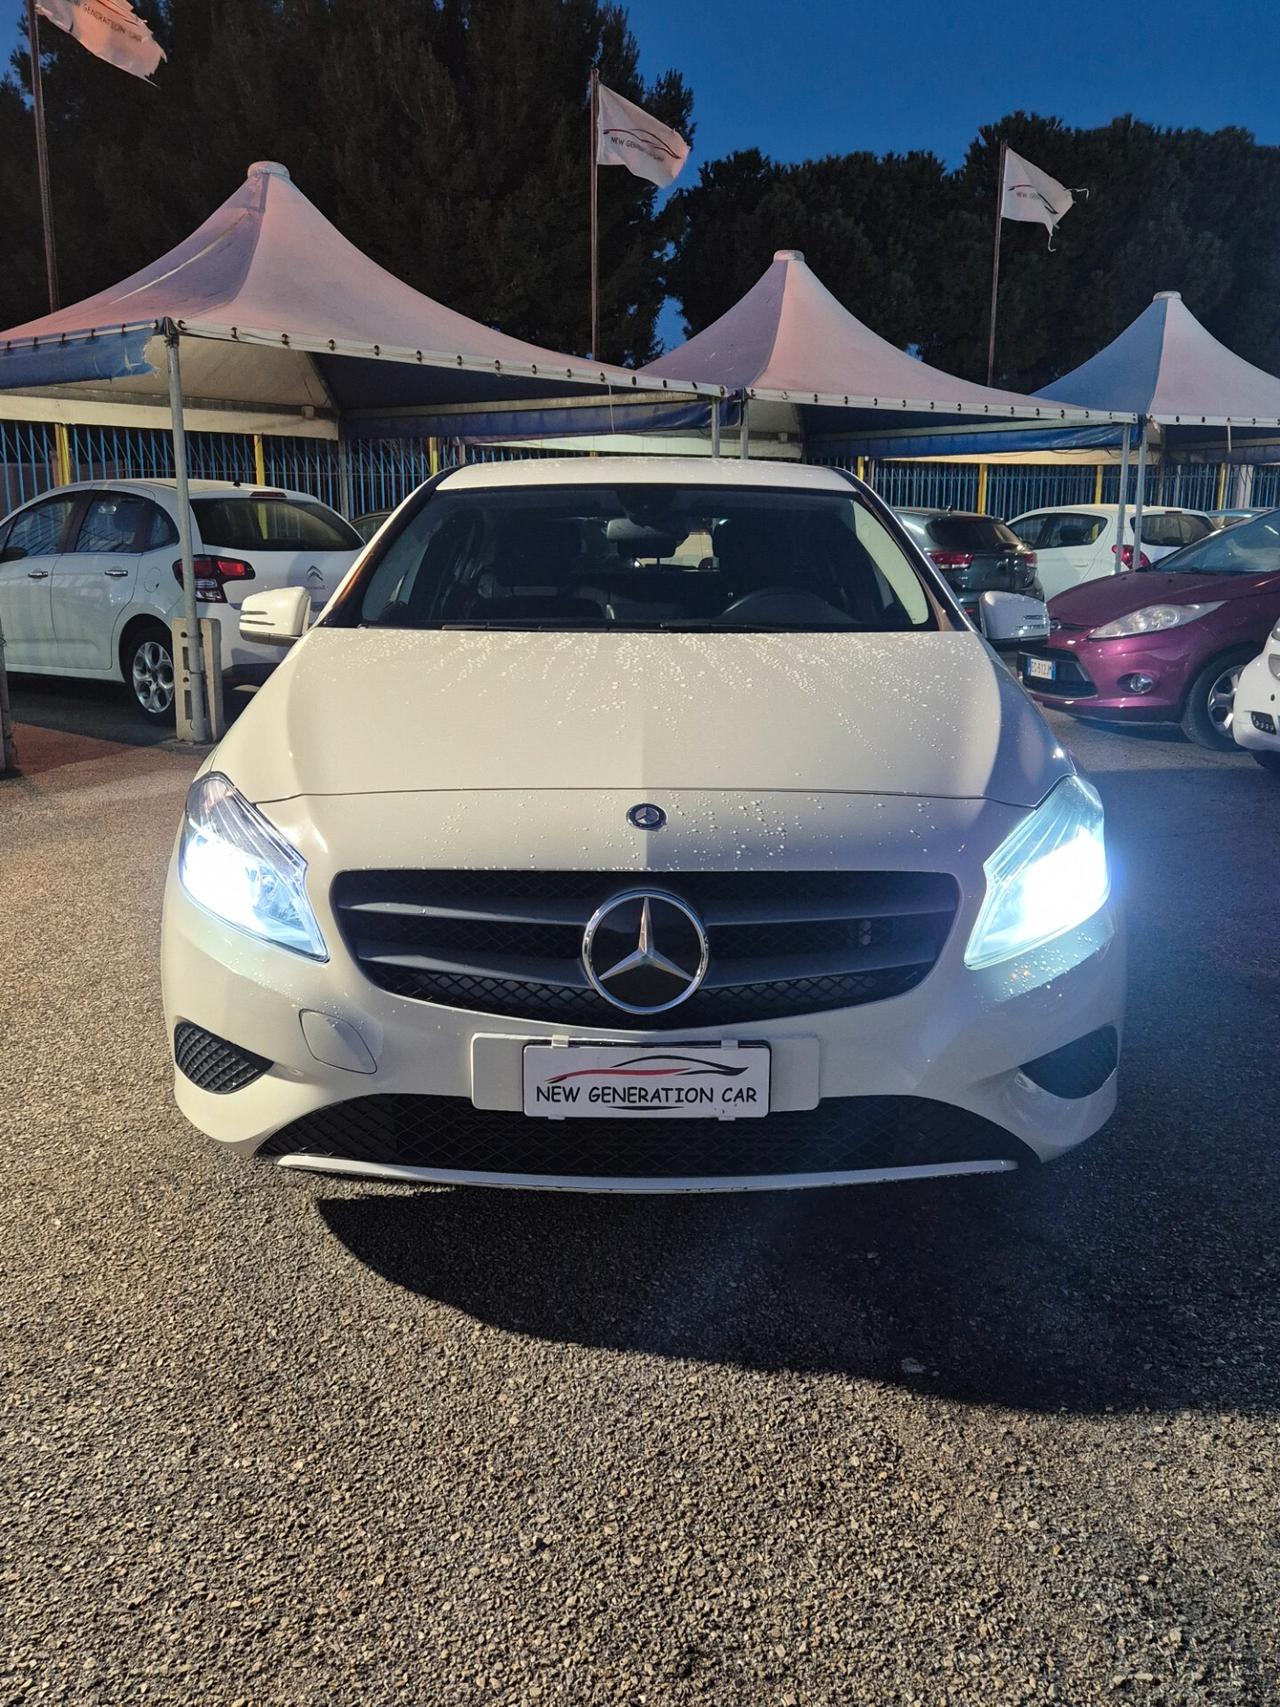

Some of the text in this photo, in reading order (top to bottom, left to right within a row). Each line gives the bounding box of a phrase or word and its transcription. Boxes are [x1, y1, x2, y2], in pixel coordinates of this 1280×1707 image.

[536, 1086, 757, 1103] NEW GENERATION CAR
